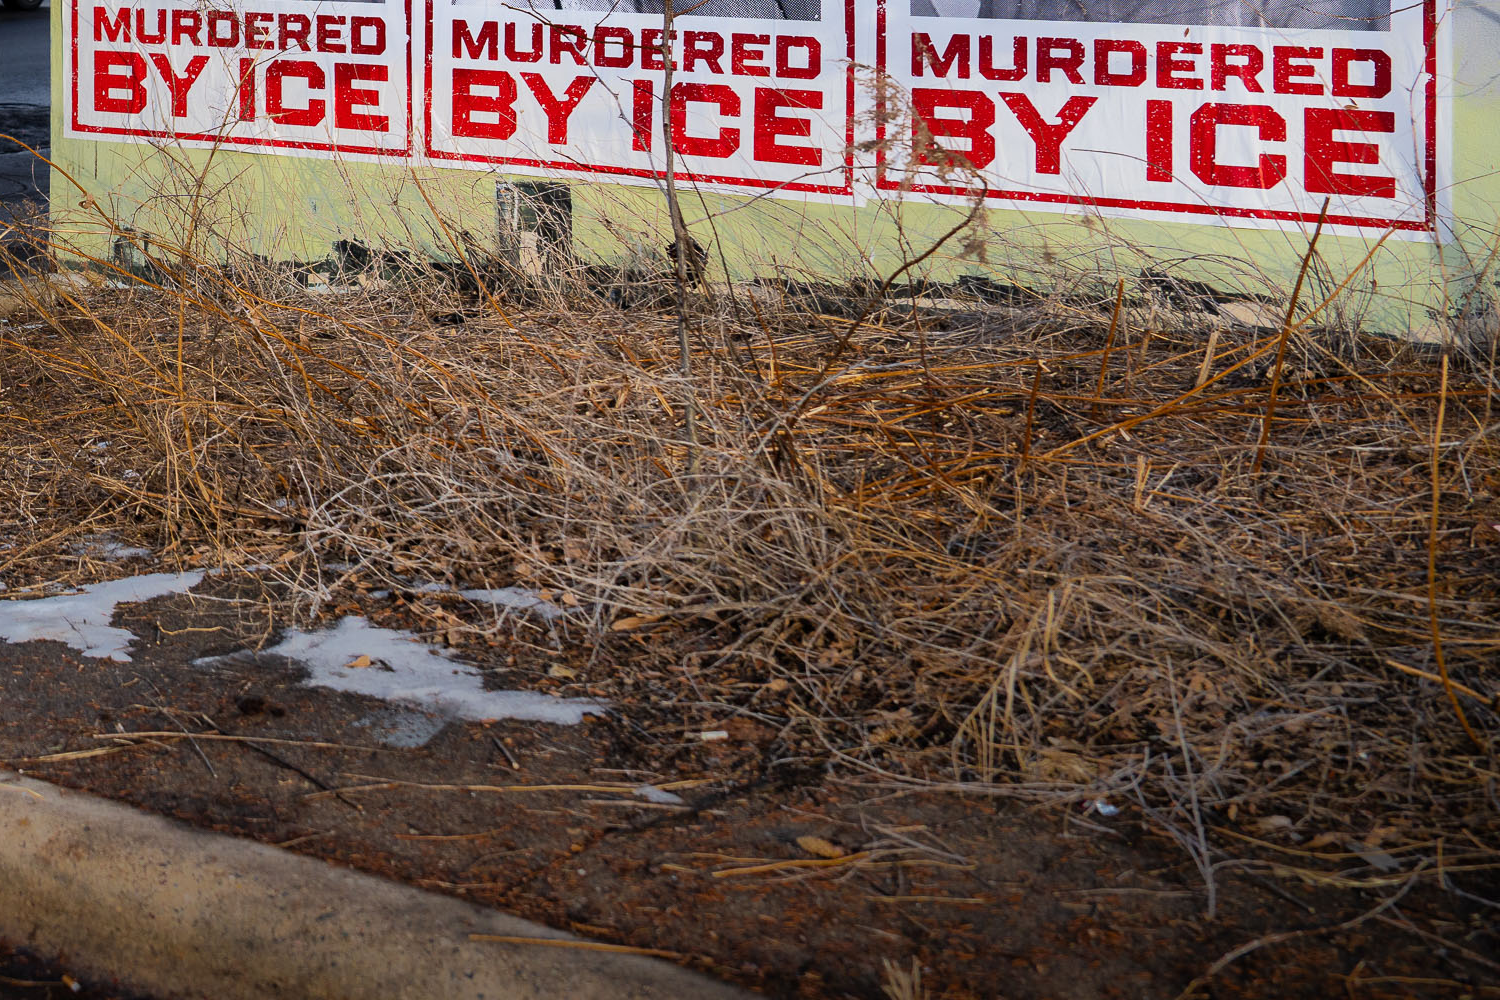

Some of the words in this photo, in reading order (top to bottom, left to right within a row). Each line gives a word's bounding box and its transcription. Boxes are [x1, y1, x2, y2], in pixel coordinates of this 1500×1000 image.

[92, 6, 388, 55] MURDERED
[452, 18, 822, 80] MURDERED
[910, 32, 1393, 99] MURDERED
[92, 50, 211, 117] BY
[238, 57, 390, 133] ICE
[452, 68, 597, 145] BY
[632, 78, 823, 167] ICE
[910, 88, 1099, 175] BY
[1145, 99, 1396, 199] ICE
